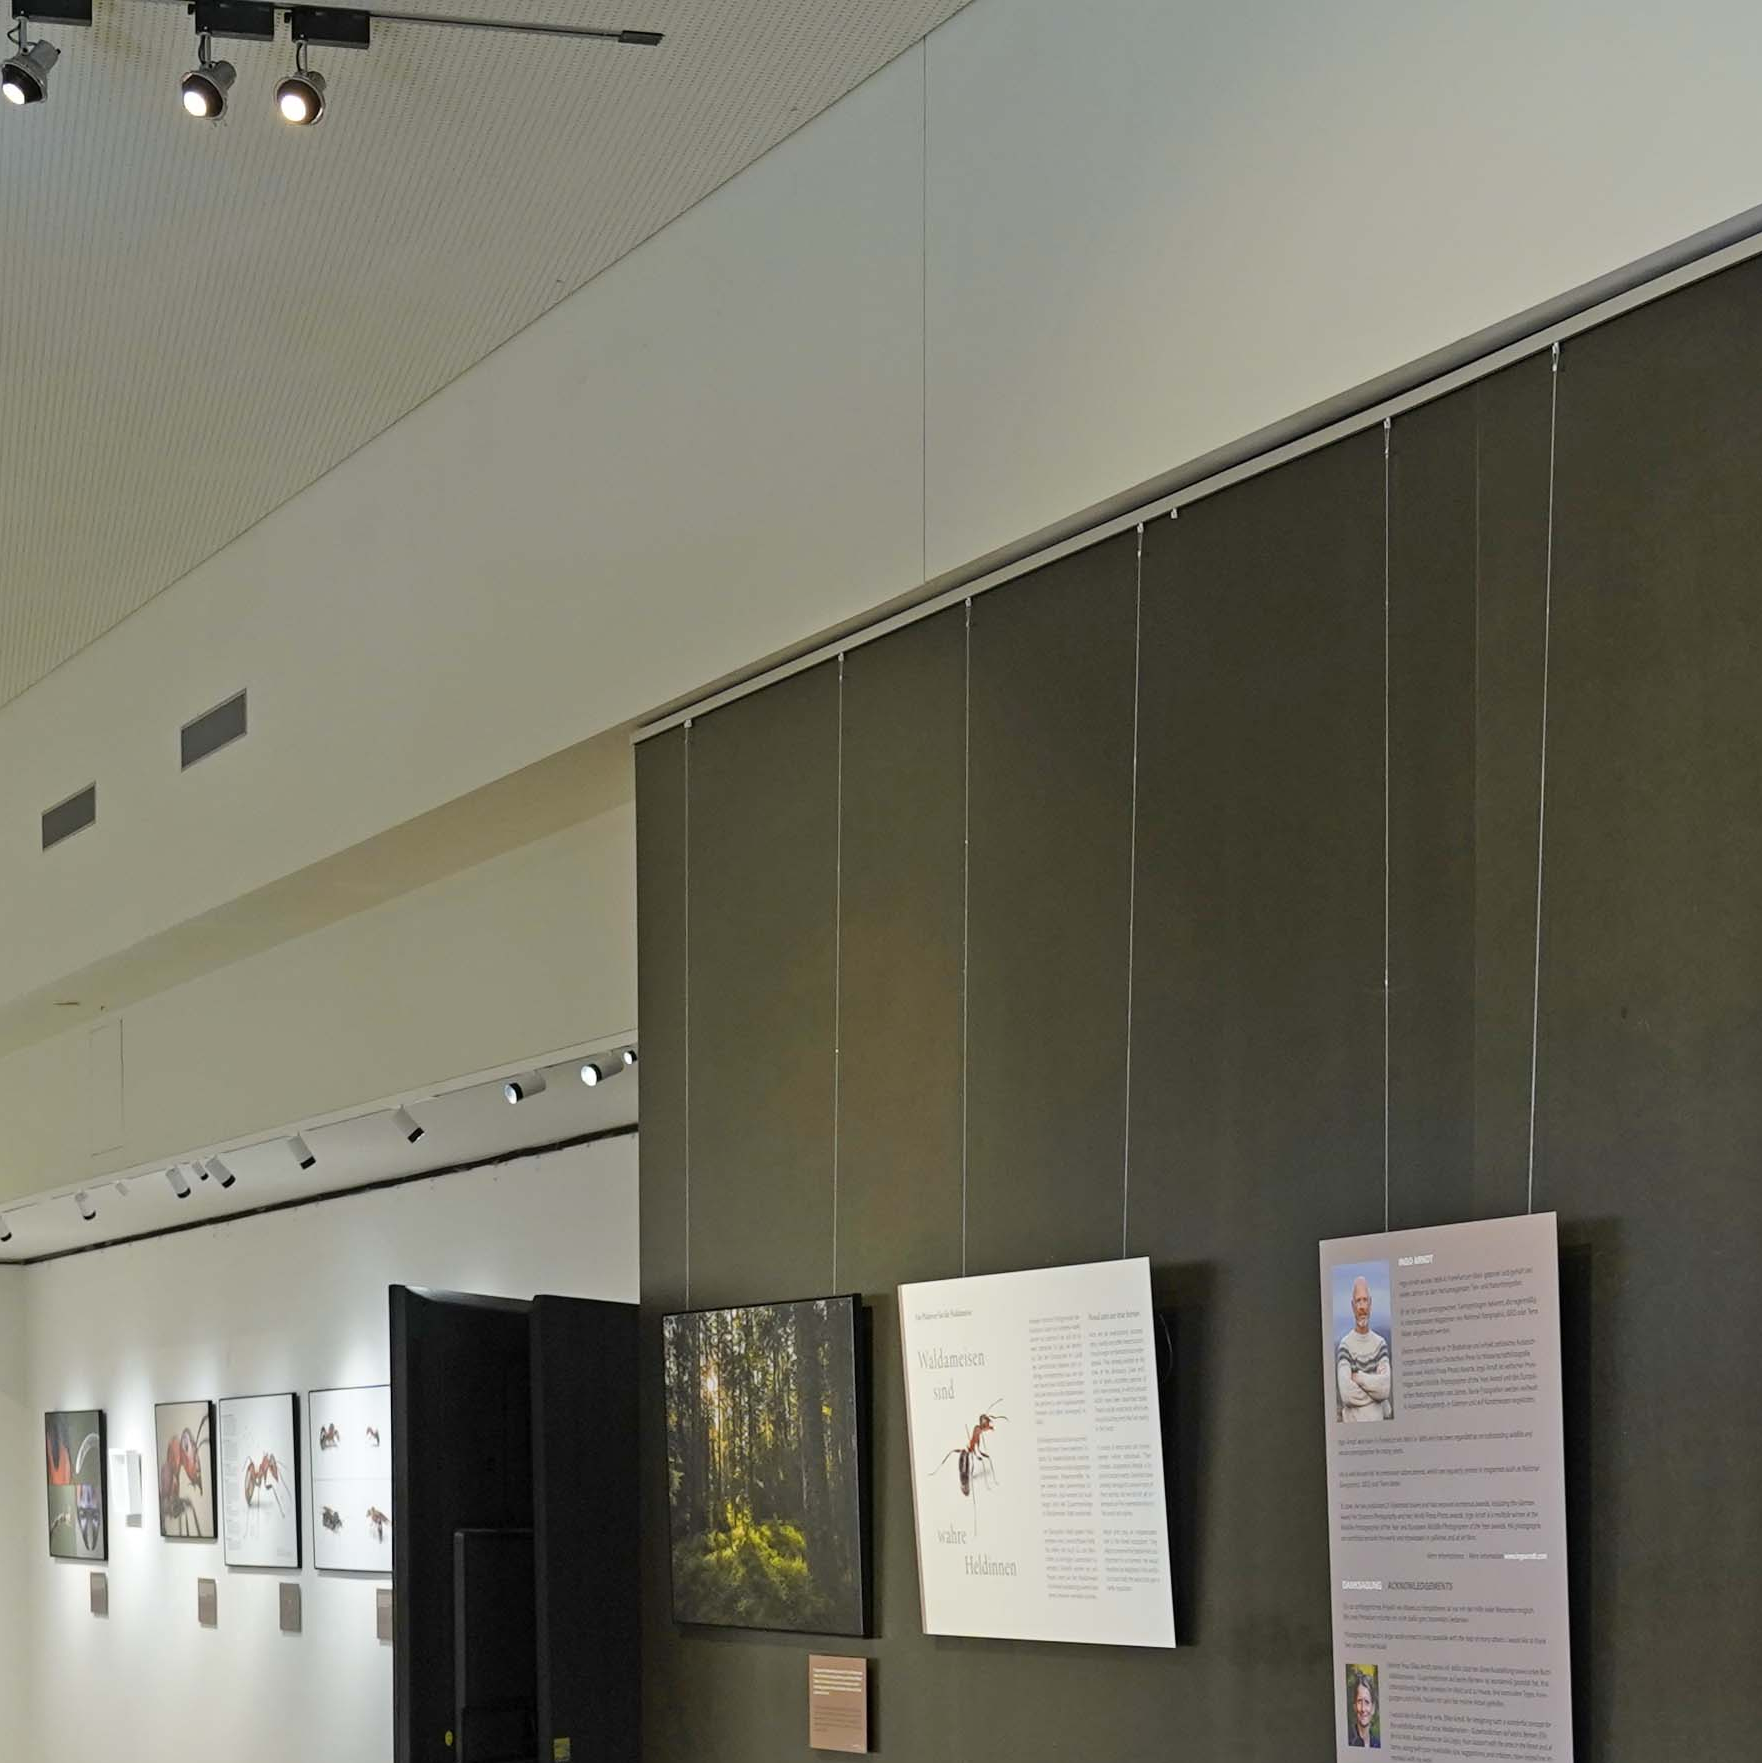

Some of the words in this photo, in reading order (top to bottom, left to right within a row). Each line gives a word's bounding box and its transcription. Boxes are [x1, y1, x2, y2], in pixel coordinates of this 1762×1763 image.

[917, 1349, 985, 1369] Waldameisen
[933, 1379, 955, 1400] sind
[937, 1524, 967, 1544] wahre
[964, 1555, 1017, 1577] Heldinnen
